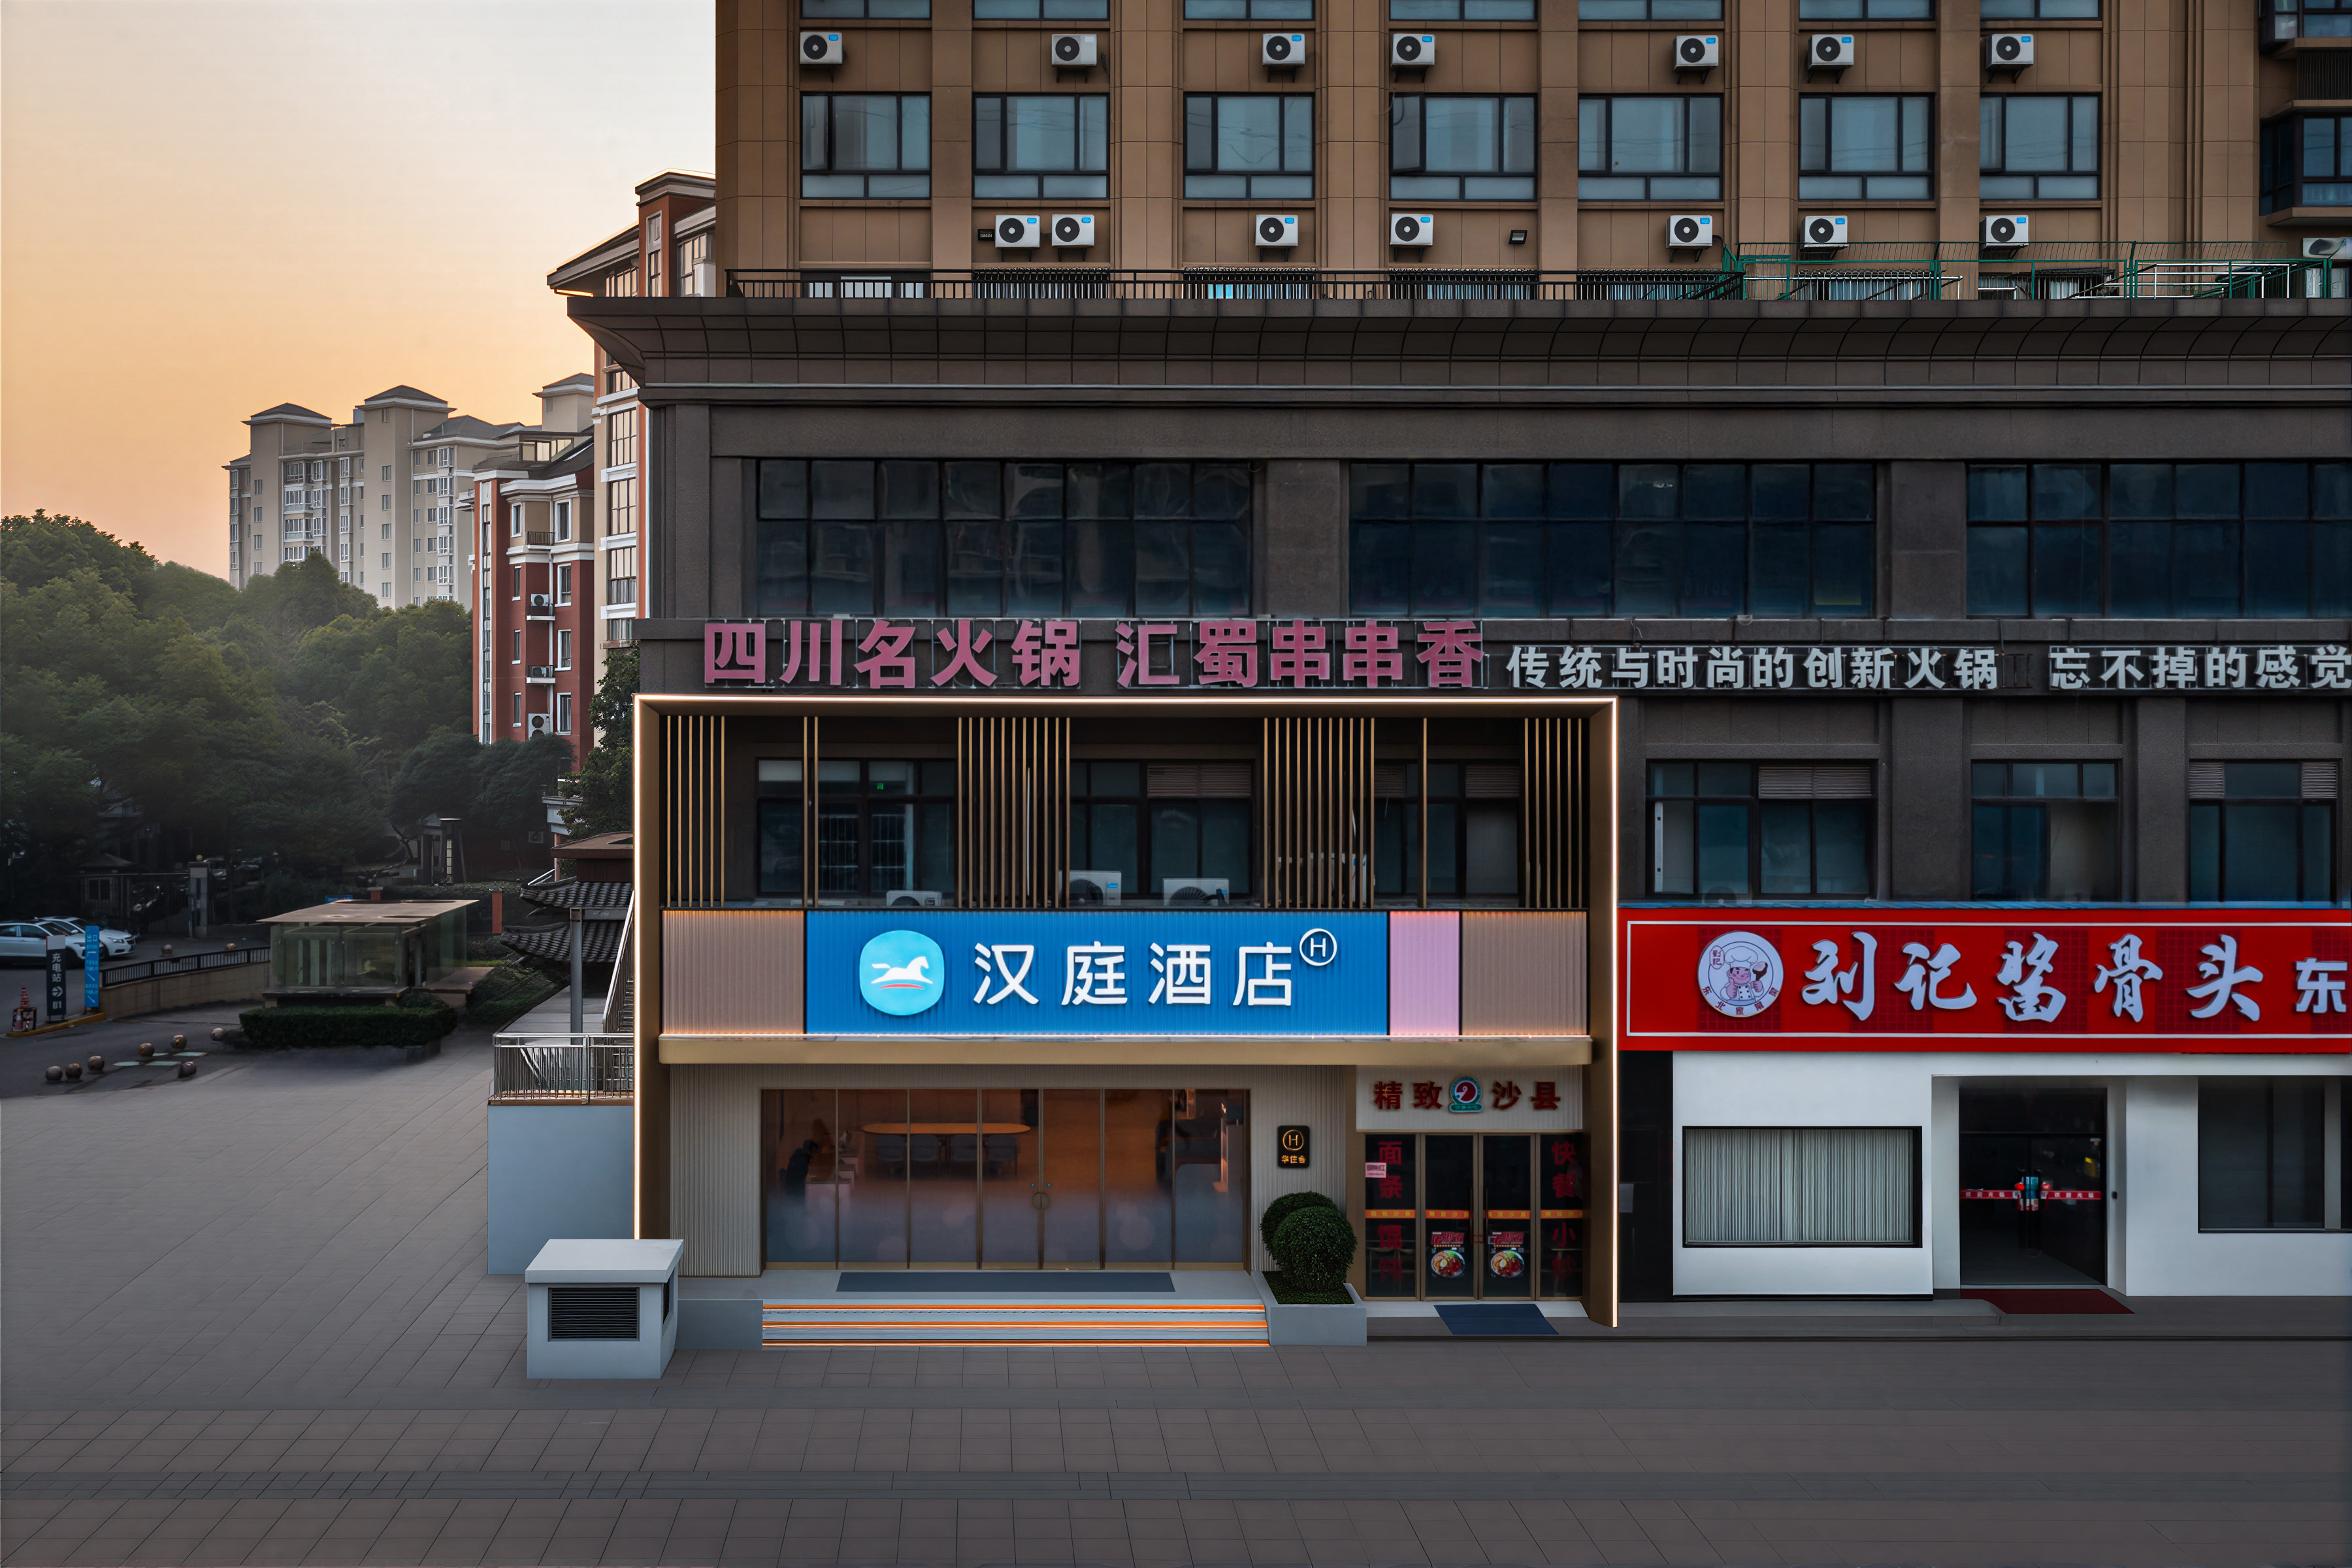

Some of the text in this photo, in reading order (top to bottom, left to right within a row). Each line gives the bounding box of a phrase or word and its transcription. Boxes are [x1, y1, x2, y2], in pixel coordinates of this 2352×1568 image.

[704, 619, 1483, 689] 四川名火锅 汇蜀串串香
[1506, 645, 2352, 689] 传统与时尚的创新火锅 忘不掉的感觉
[52, 953, 62, 983] 充电站
[972, 941, 1293, 1007] 汉庭酒店
[2295, 957, 2348, 1013] 东
[52, 1001, 62, 1009] B1
[1374, 1081, 1443, 1110] 精致
[1492, 1081, 1561, 1110] 沙县
[1281, 1154, 1306, 1164] 华住会
[1378, 1141, 1403, 1199] 面条
[1551, 1140, 1576, 1198] 快餐
[1377, 1224, 1403, 1282] 馄饨
